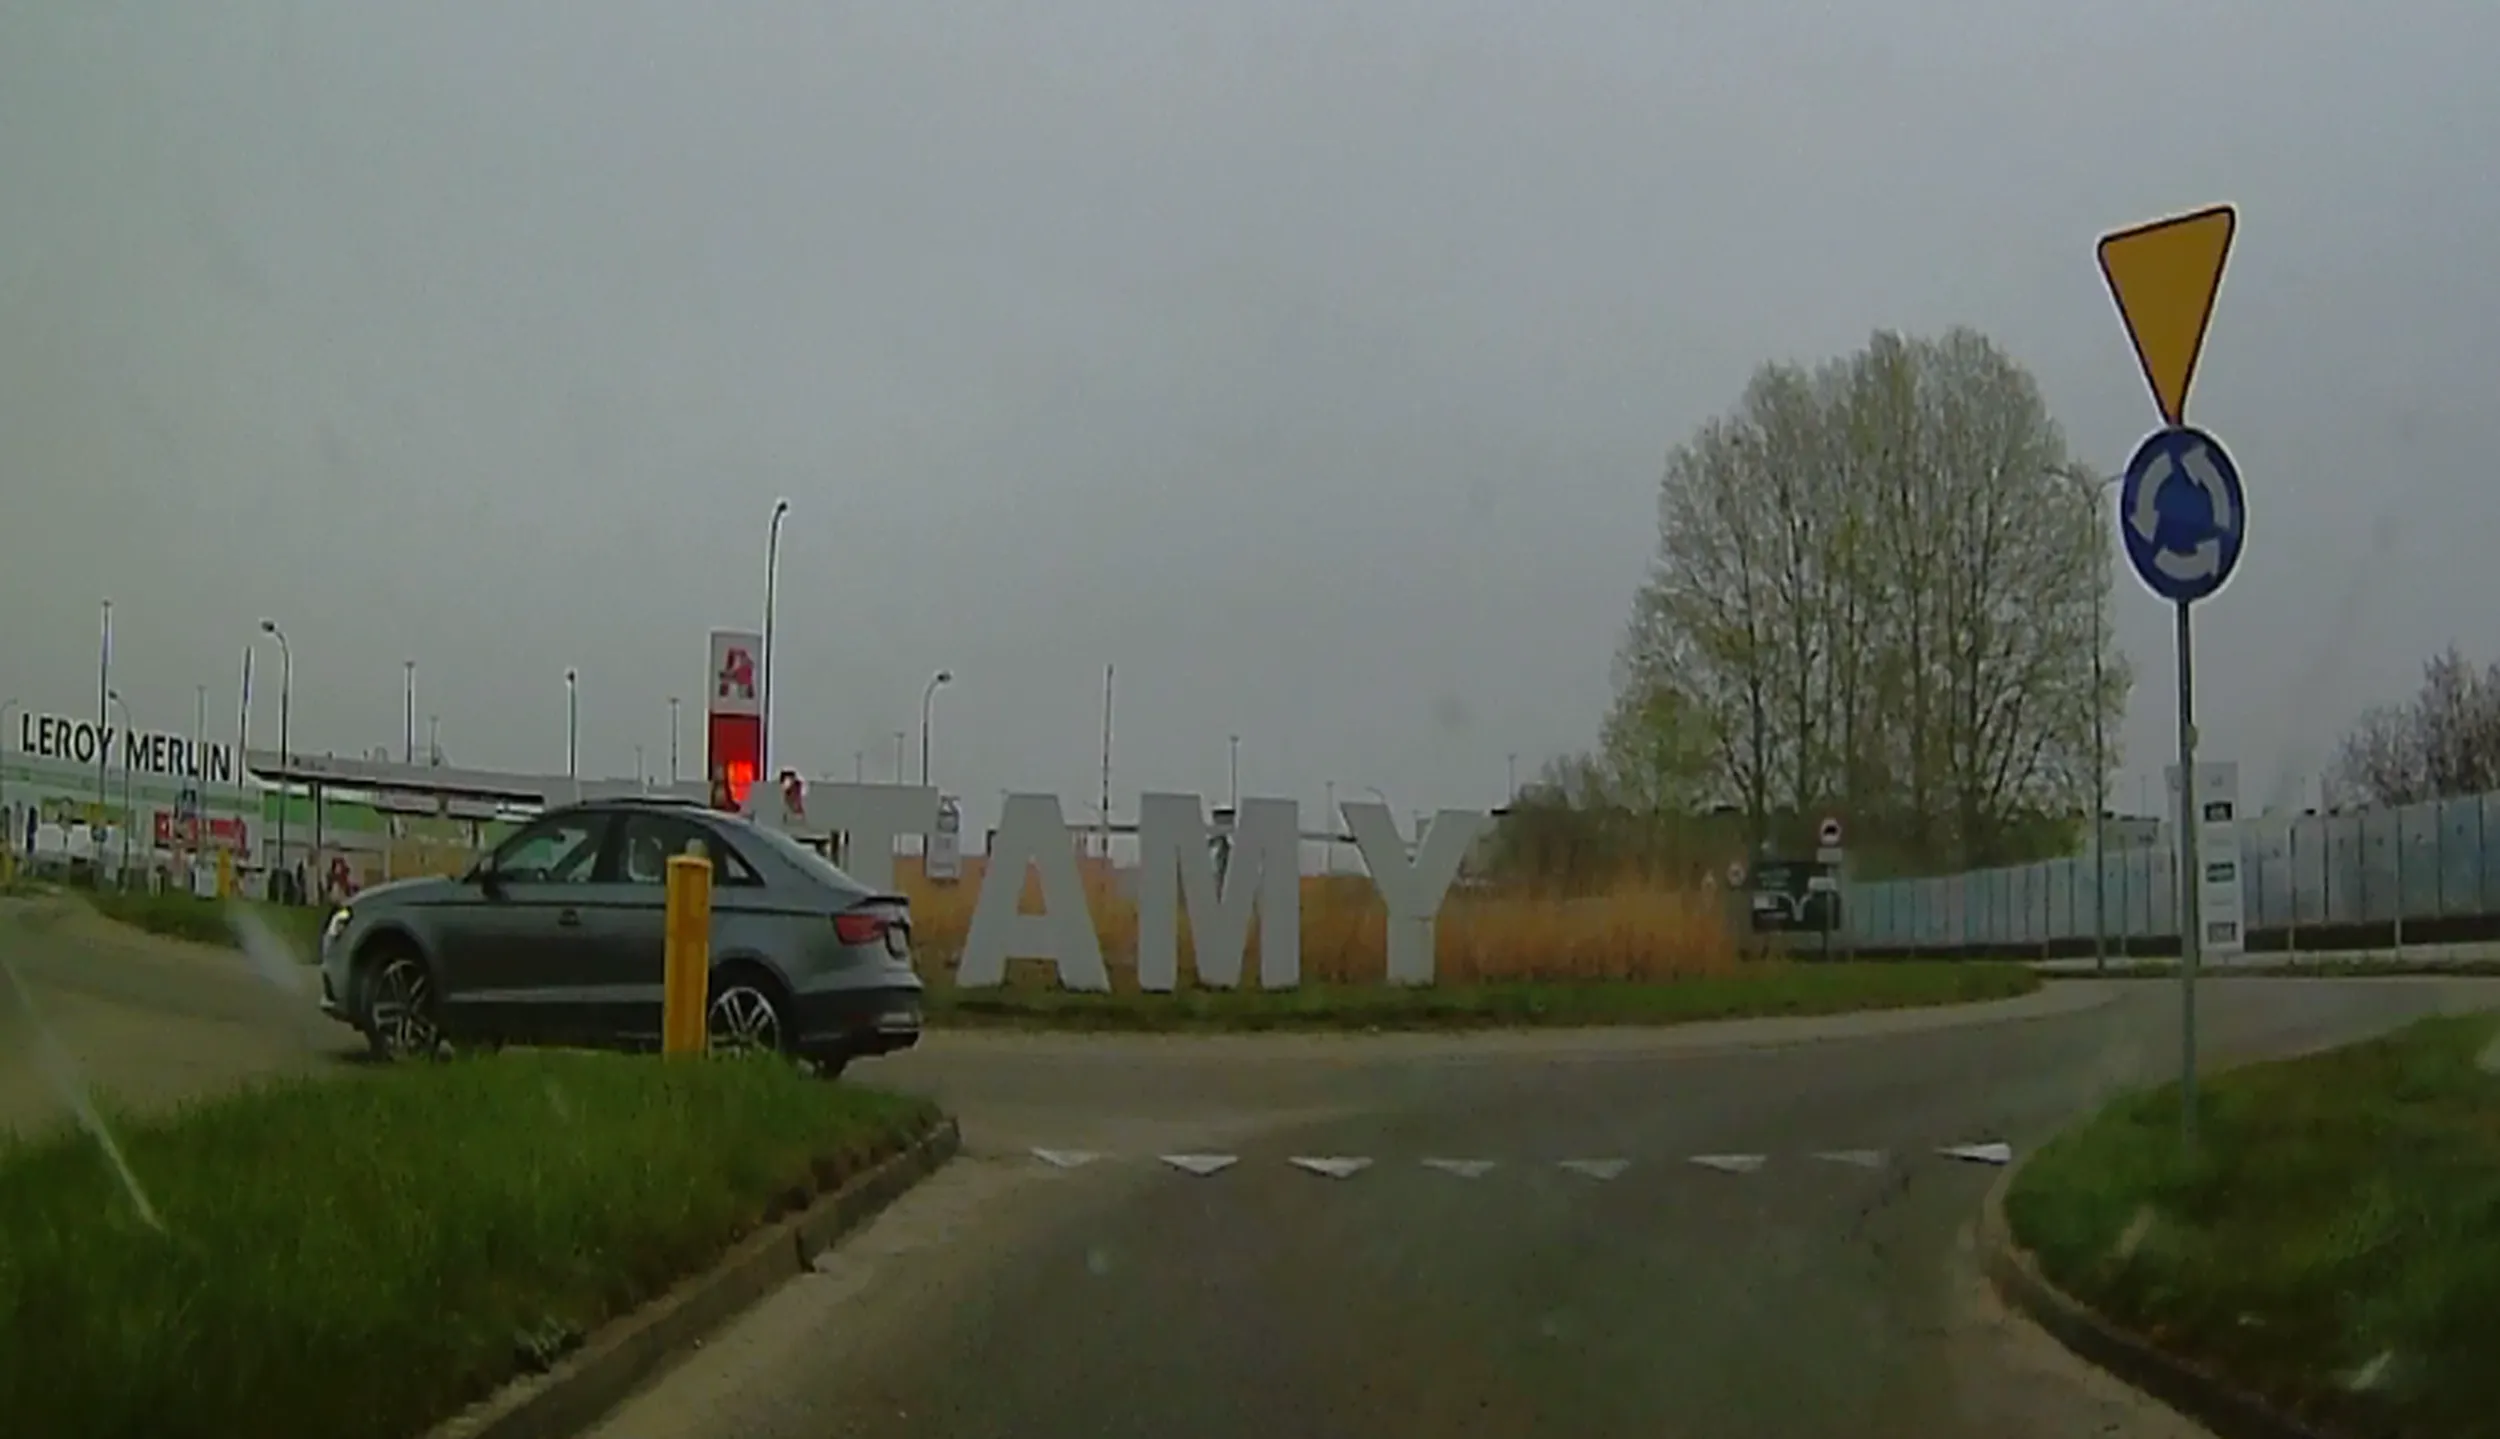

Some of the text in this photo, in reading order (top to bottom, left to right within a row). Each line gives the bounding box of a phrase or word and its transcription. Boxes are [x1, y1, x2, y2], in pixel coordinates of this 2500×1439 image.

[22, 713, 232, 782] LEROY MERLIN
[640, 779, 1486, 992] TAMY
